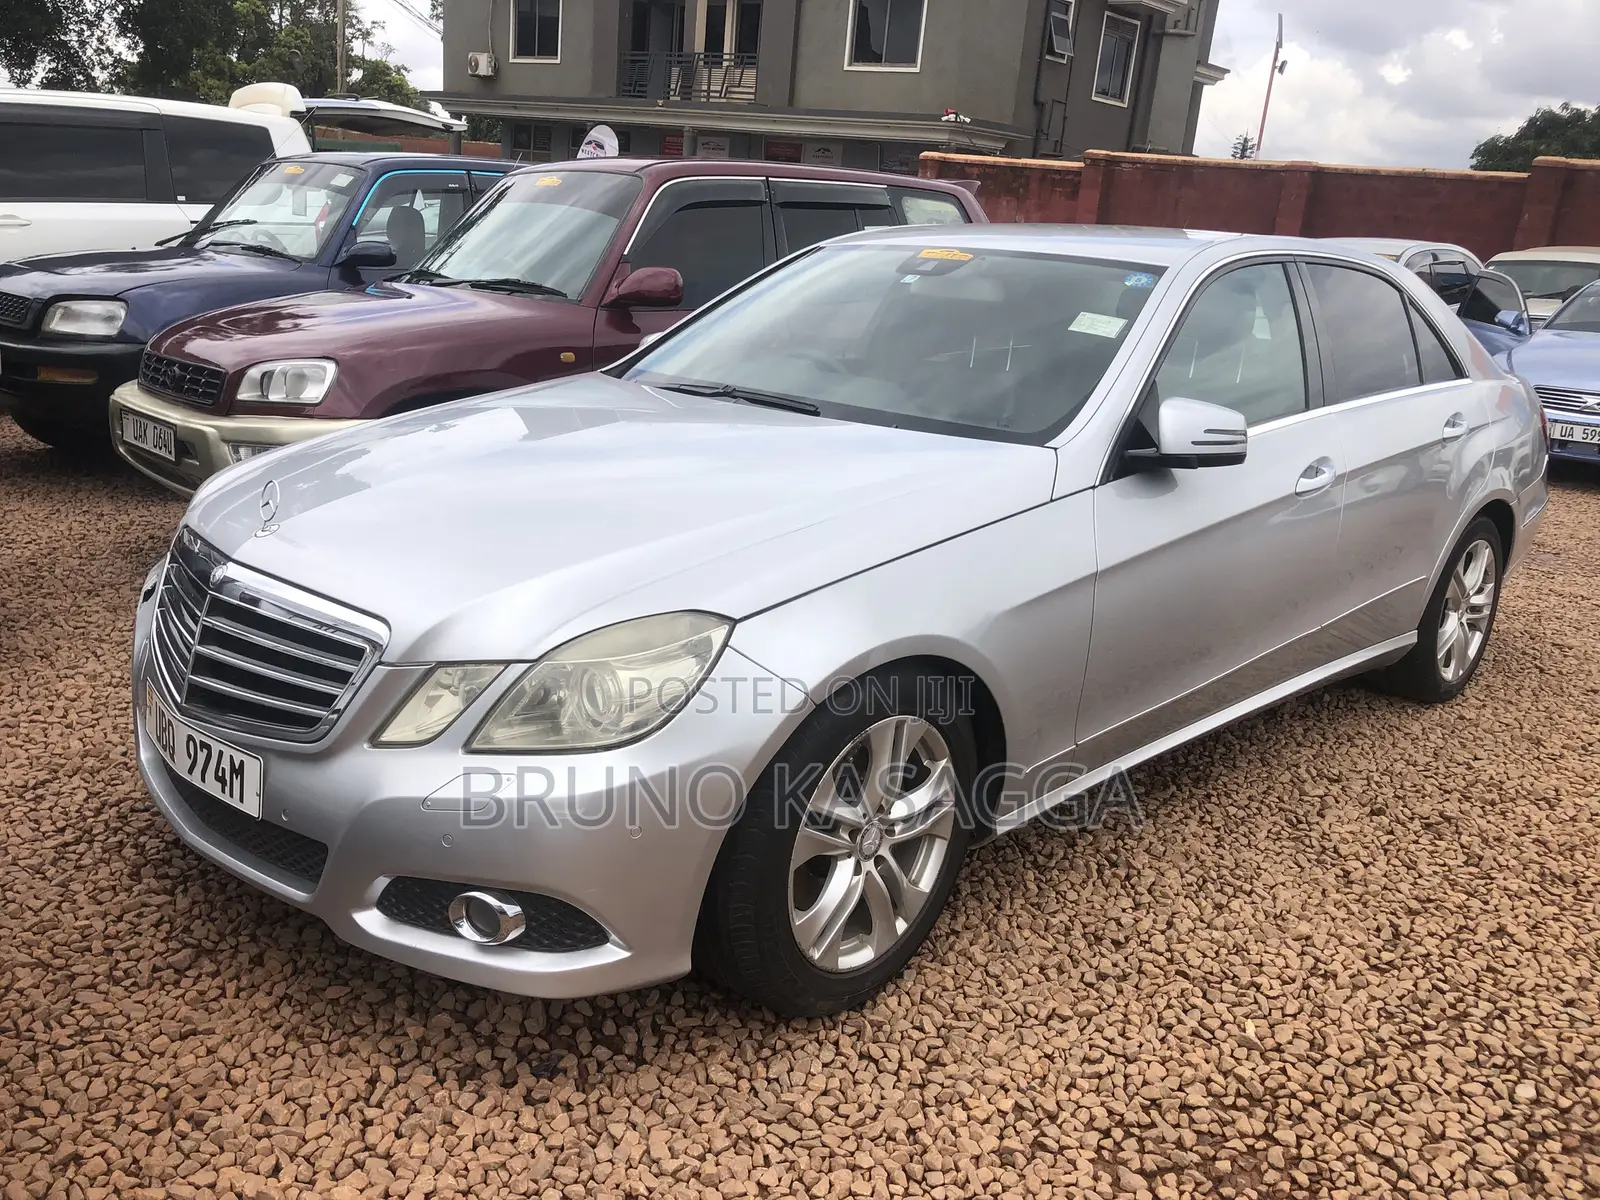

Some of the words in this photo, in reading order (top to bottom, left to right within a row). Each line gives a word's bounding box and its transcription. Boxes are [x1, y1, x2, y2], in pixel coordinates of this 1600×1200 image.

[132, 417, 148, 446] UAK
[153, 425, 173, 455] 064U
[1560, 425, 1574, 439] UA
[155, 700, 176, 764] UBQ
[186, 733, 245, 804] 974M
